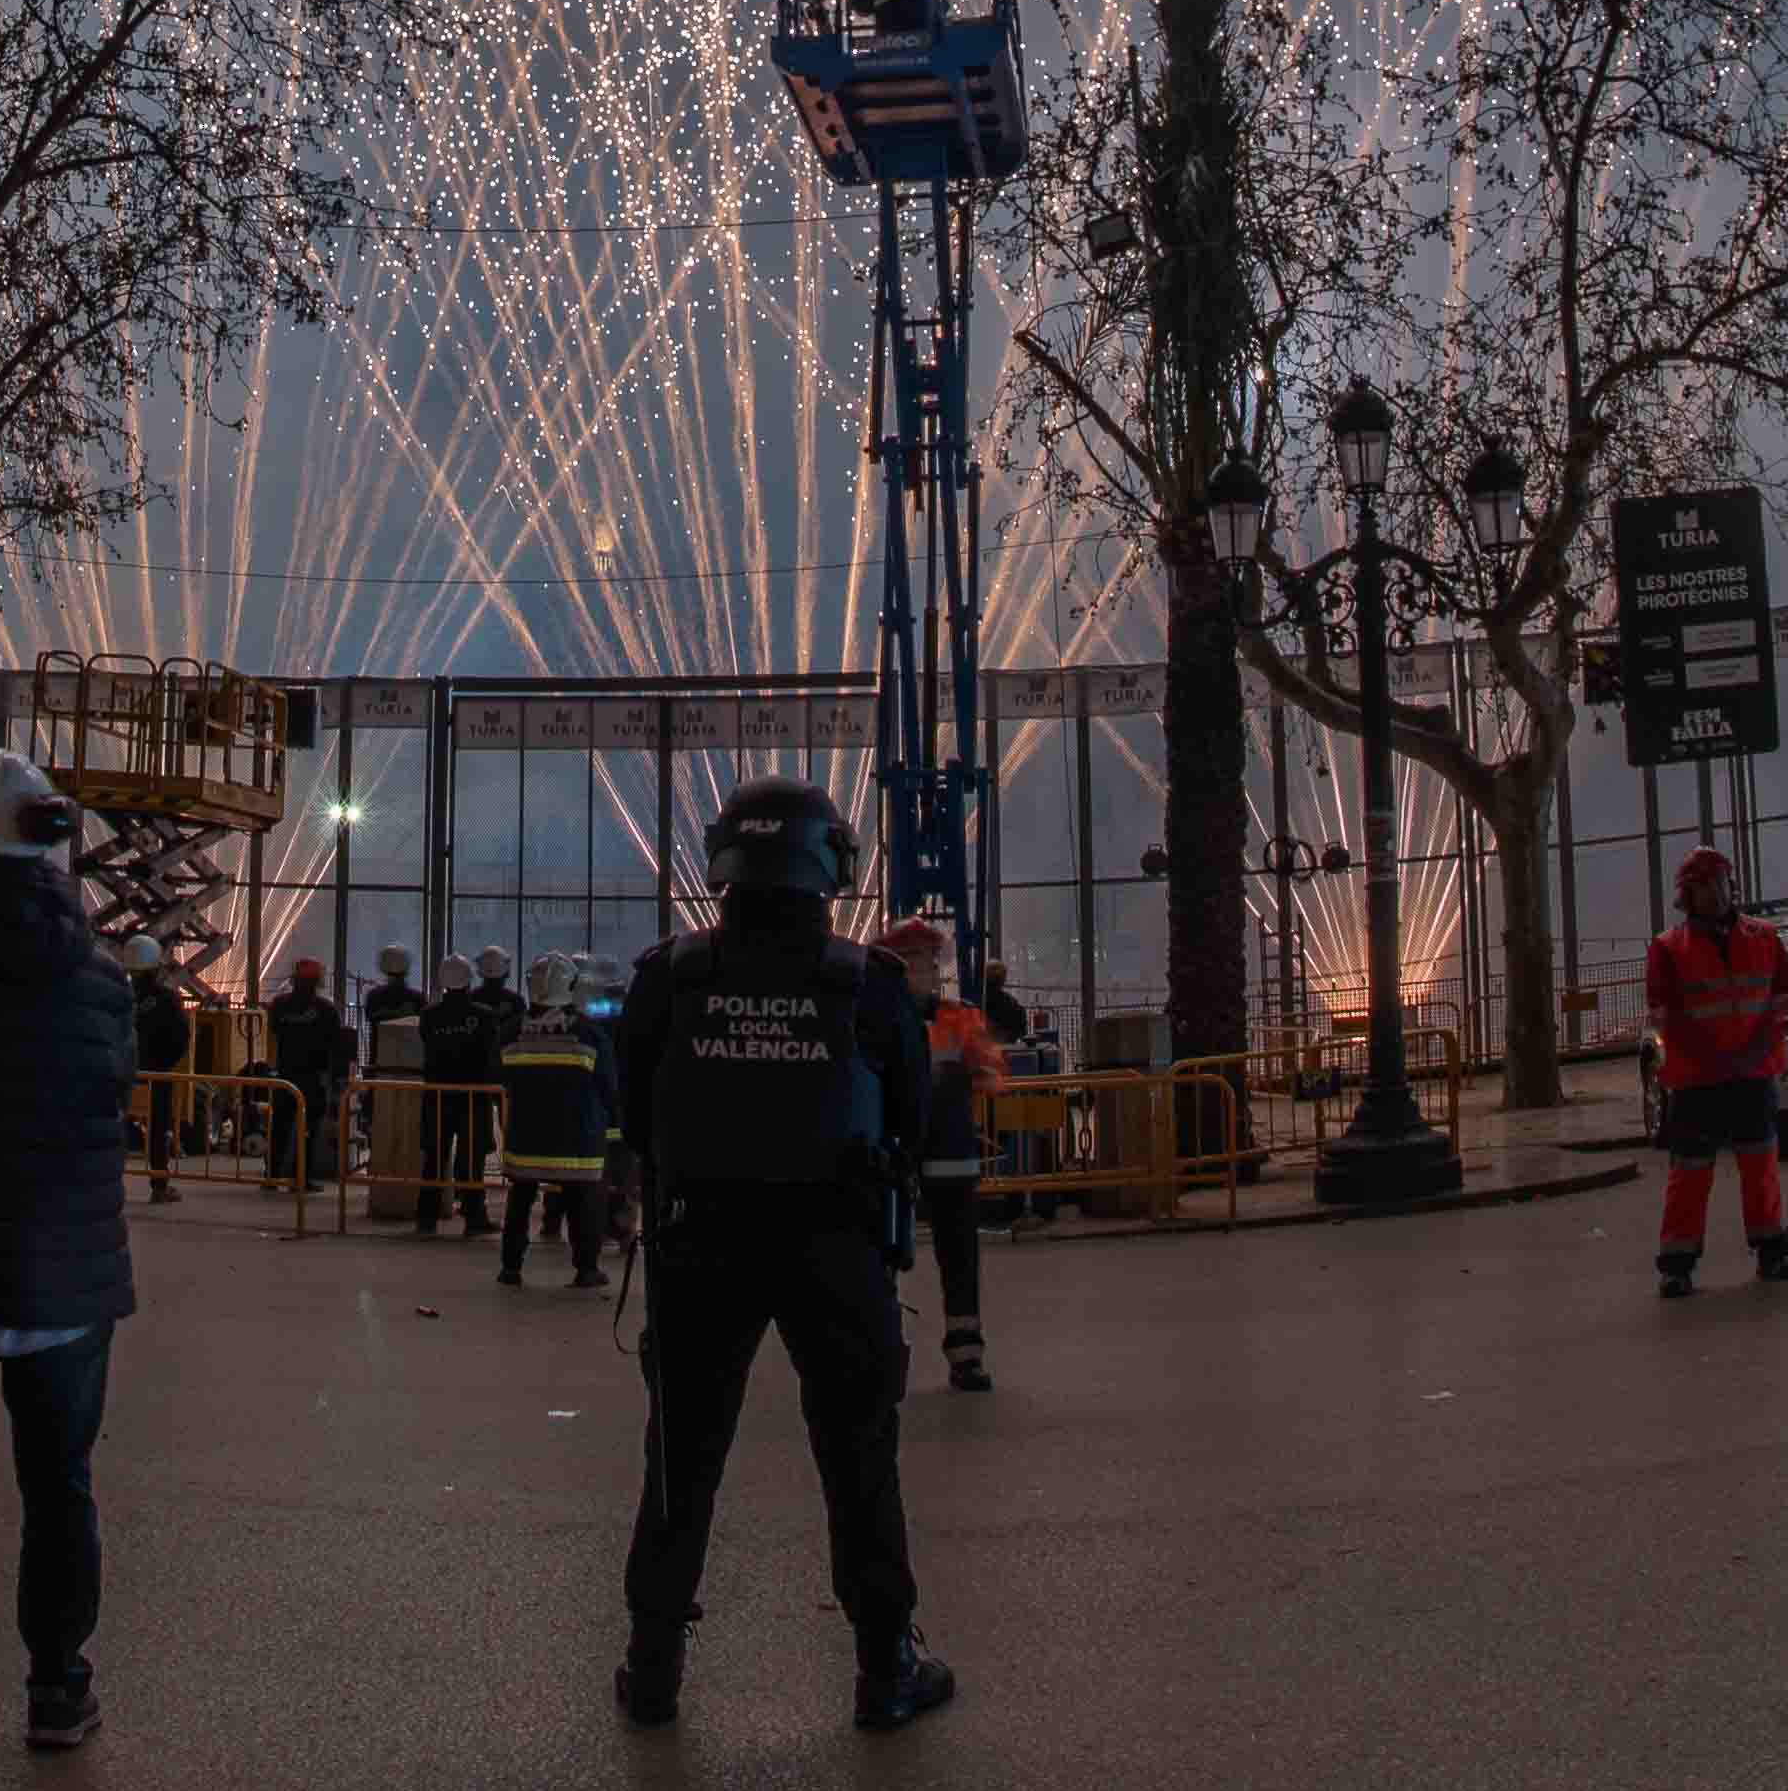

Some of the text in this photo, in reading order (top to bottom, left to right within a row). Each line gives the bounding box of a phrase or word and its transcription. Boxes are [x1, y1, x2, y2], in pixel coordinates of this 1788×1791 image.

[1658, 529, 1720, 549] TURIA
[1636, 565, 1749, 592] LES NOSTRES
[707, 994, 819, 1018] POLICIA
[729, 1019, 794, 1037] LOCAL
